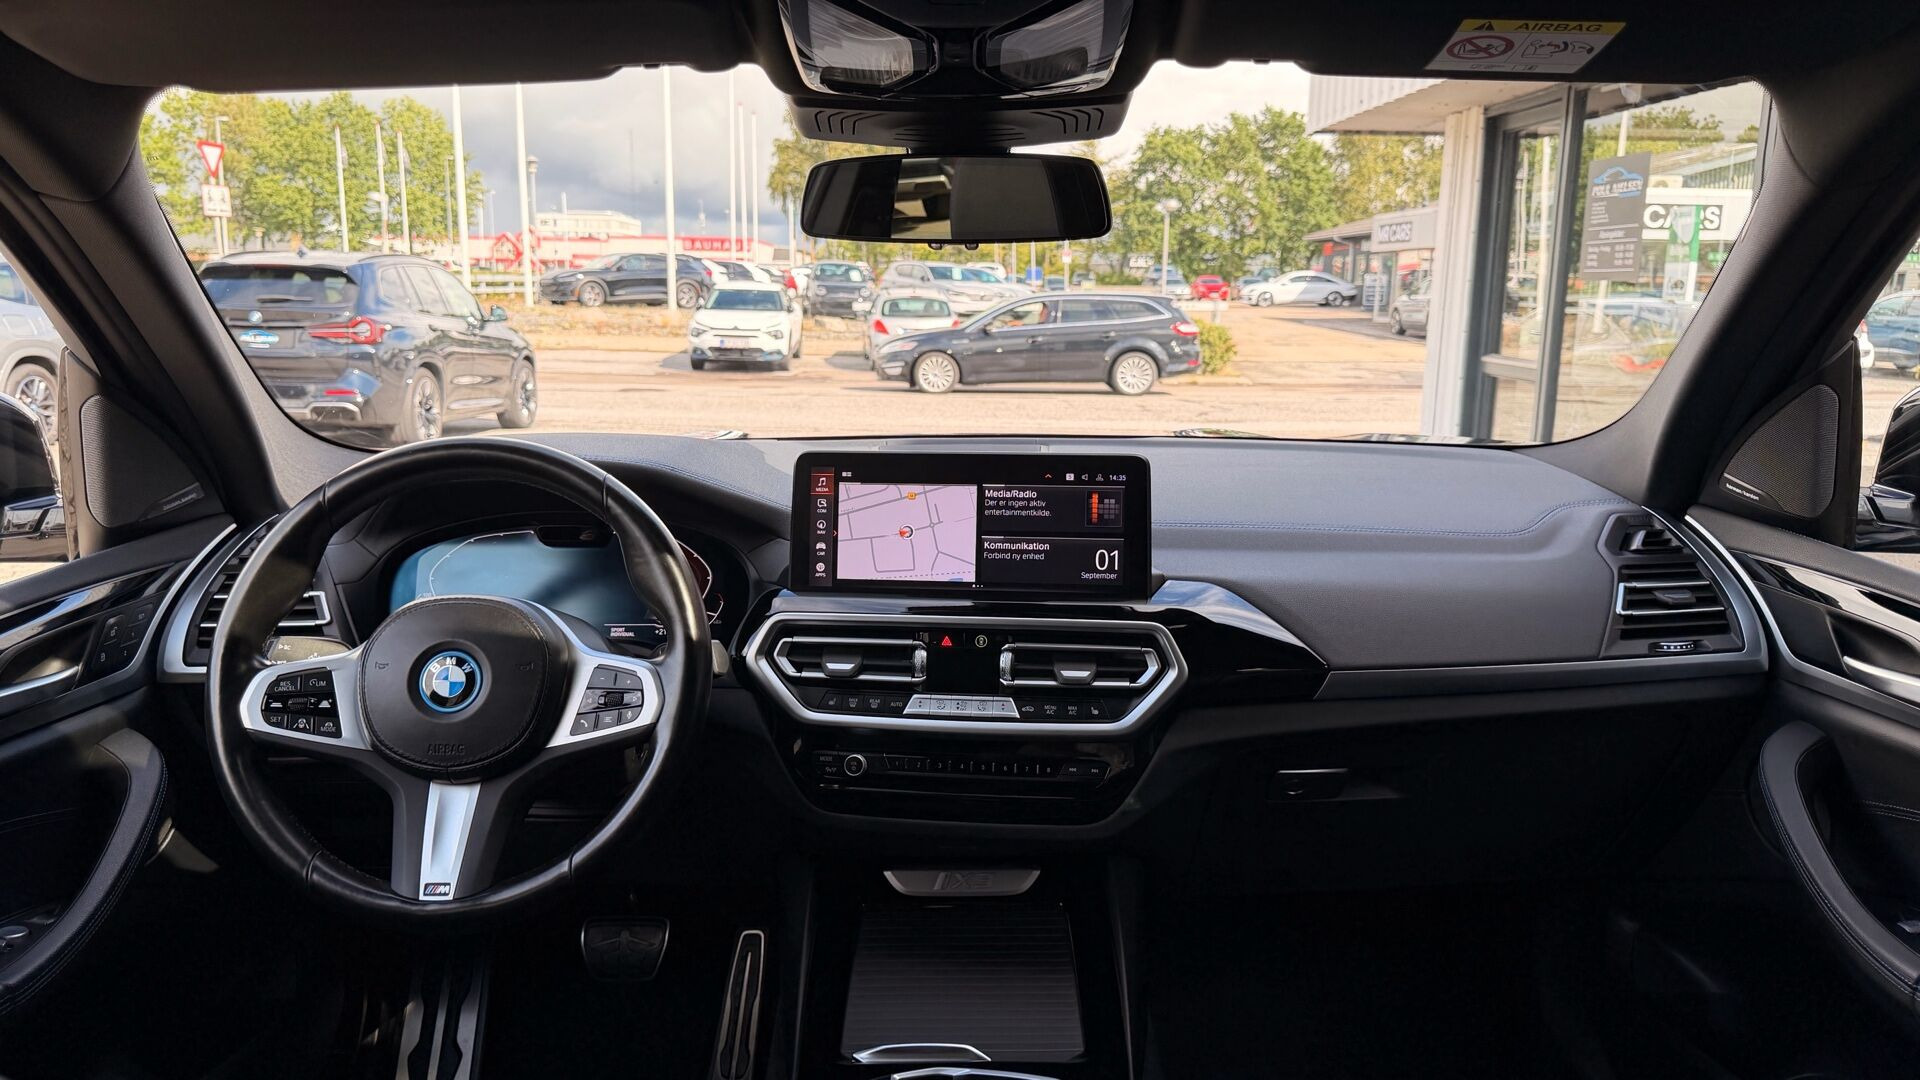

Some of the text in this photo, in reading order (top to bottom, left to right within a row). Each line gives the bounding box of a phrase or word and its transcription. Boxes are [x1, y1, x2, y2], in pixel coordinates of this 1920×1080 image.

[1514, 22, 1603, 33] AIRBAG
[985, 489, 1037, 498] Media/Radio
[984, 499, 997, 507] Der
[1007, 500, 1027, 509] ingen
[1029, 499, 1046, 507] aktiv
[984, 541, 1050, 551] Kommunikation
[984, 551, 1011, 560] Forbind
[1095, 549, 1119, 571] 01
[1080, 572, 1118, 580] September
[430, 656, 473, 673] BMW
[427, 743, 466, 756] AIRBAG
